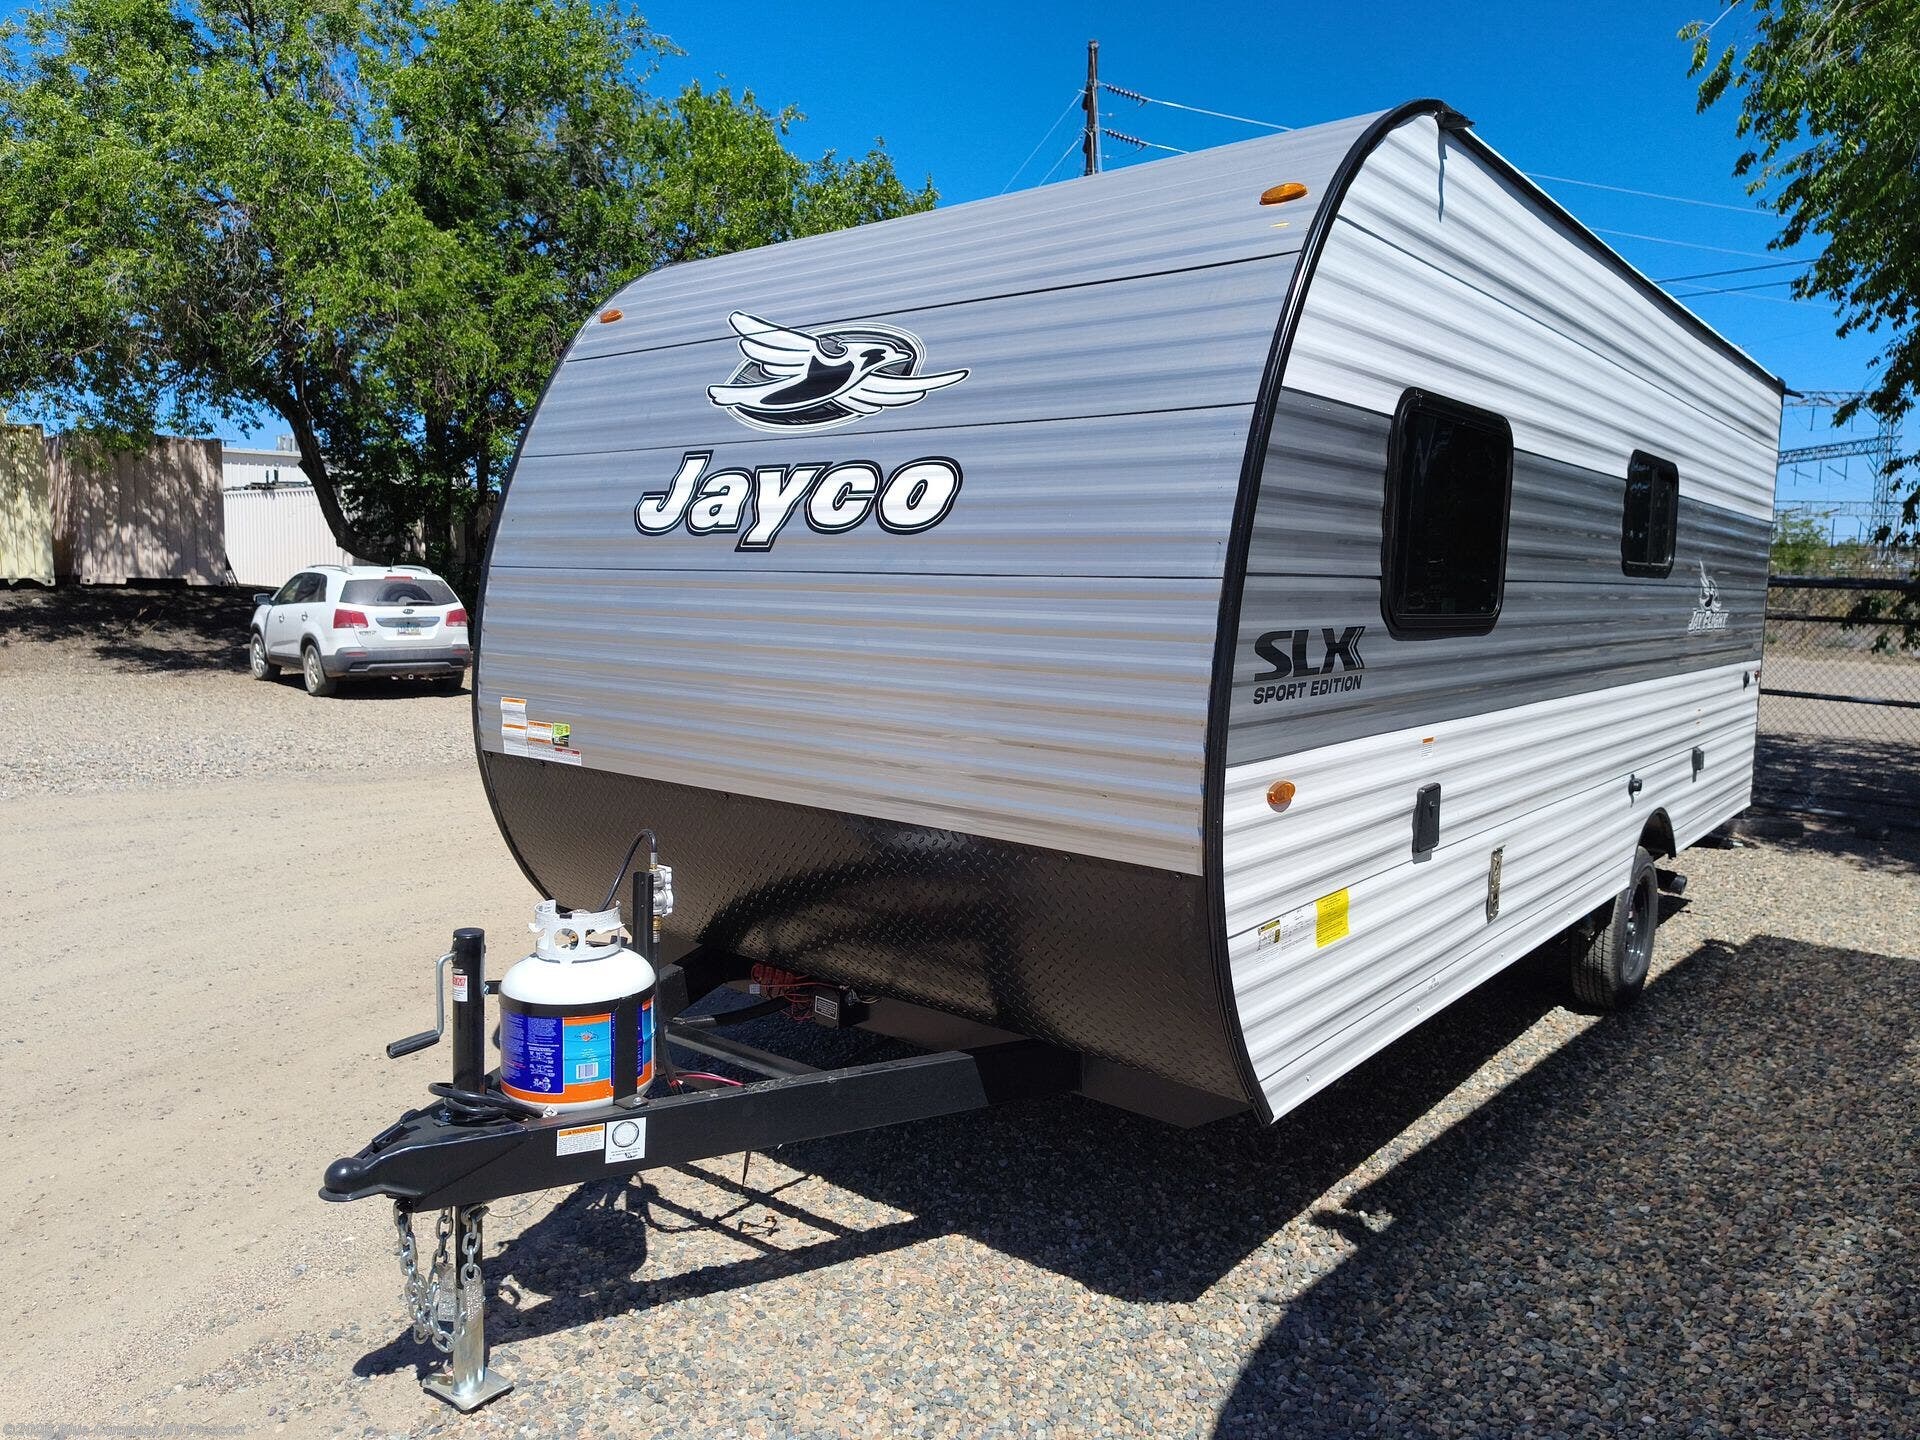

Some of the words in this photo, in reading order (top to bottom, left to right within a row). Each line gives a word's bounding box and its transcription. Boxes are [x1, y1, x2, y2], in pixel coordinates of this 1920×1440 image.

[634, 450, 963, 552] Jayco
[1254, 626, 1366, 682] SLX
[1253, 682, 1307, 705] SPORT
[1310, 675, 1363, 697] EDITION
